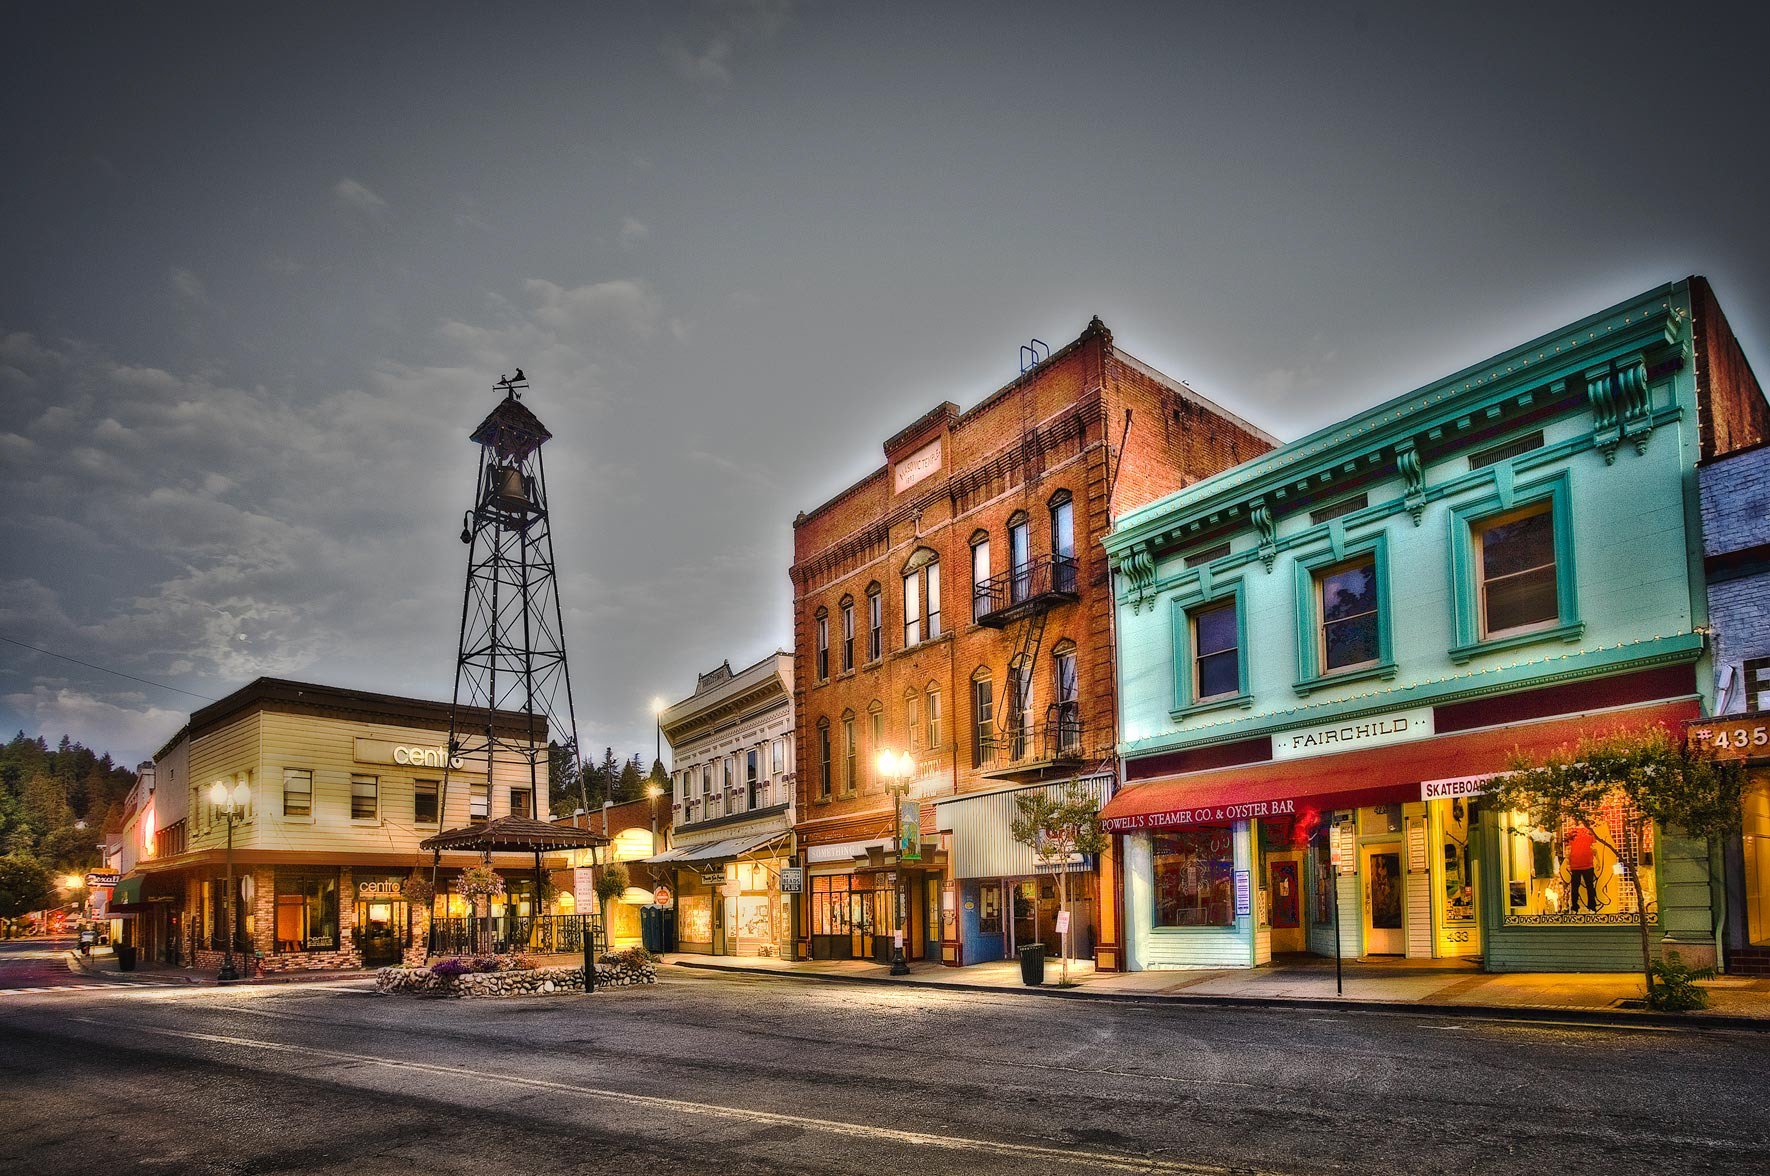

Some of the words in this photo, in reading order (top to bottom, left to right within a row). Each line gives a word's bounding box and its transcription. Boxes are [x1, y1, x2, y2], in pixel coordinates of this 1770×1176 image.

[1293, 718, 1409, 748] FAIRCHILD
[1101, 815, 1145, 832] POWELL'S
[1148, 812, 1193, 827] STEAMER
[1195, 809, 1214, 822] CO.
[1216, 809, 1224, 819] &
[1226, 803, 1269, 819] OYSTER
[1271, 800, 1295, 814] BAR
[813, 844, 856, 858] SOMETHING
[360, 880, 400, 892] centro
[1609, 914, 1624, 923] DVS
[1447, 931, 1469, 943] 433
